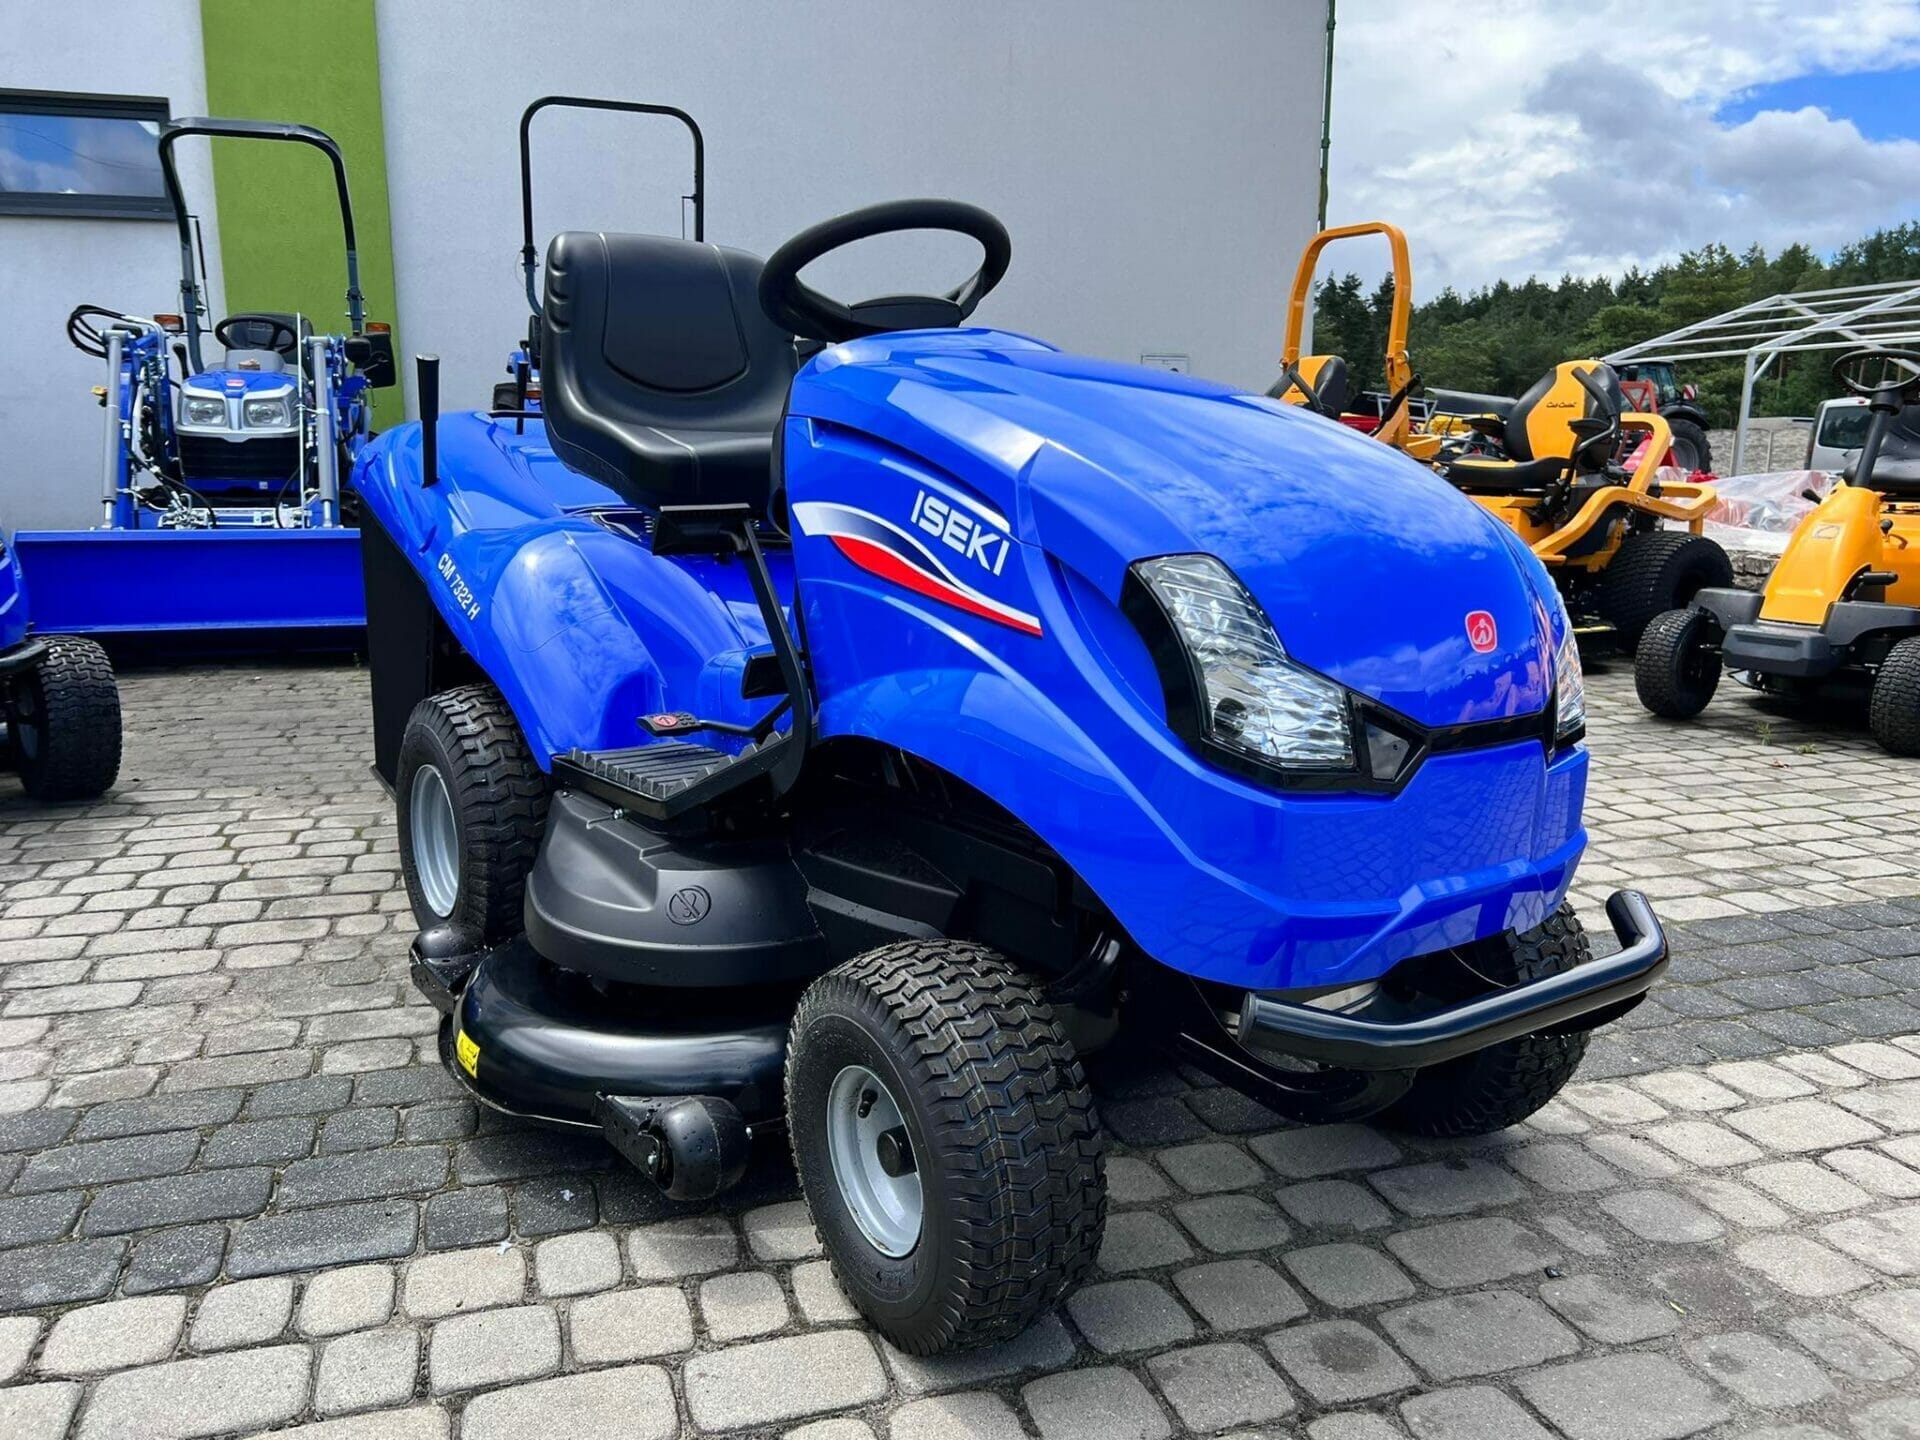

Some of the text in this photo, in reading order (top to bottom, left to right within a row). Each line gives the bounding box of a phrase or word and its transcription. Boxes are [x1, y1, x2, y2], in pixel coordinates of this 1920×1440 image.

[910, 489, 1010, 577] ISEKI
[438, 552, 481, 621] CM 7322 H
